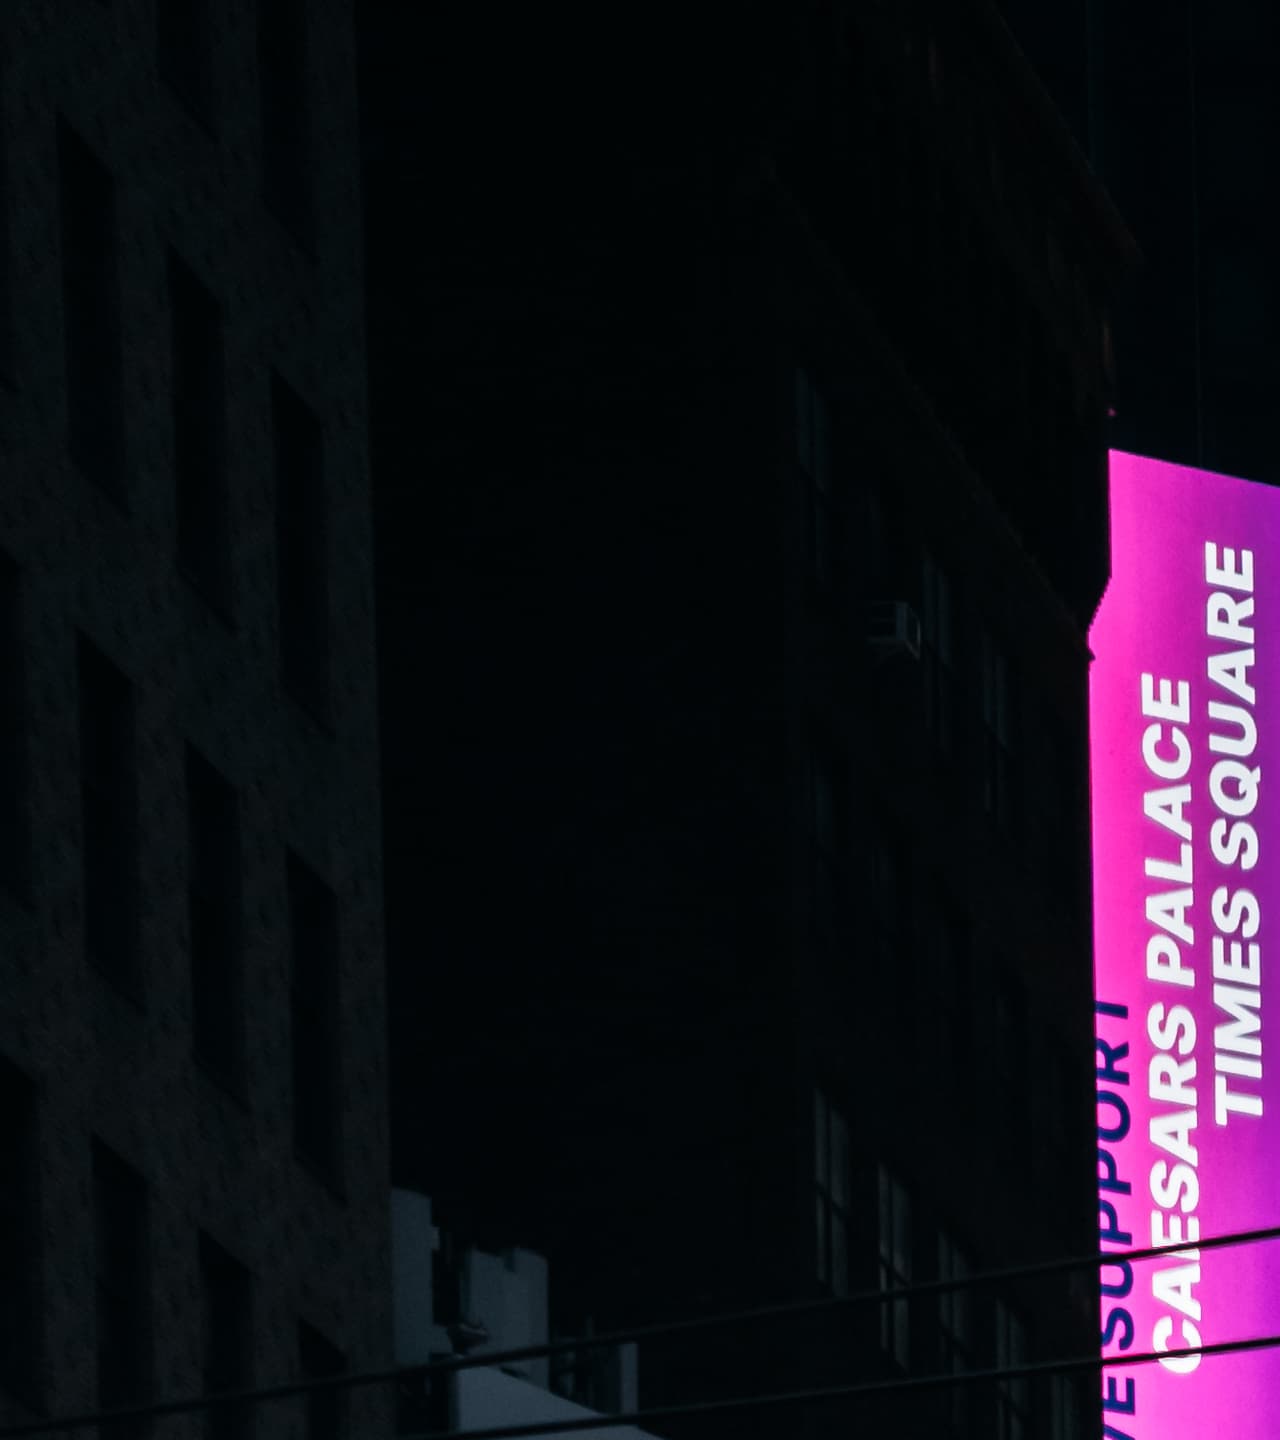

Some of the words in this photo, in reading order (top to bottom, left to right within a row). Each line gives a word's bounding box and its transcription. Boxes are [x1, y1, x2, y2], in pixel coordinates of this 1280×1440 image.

[1141, 672, 1196, 987] PALACE
[1205, 541, 1261, 871] SQUARE
[1211, 886, 1264, 1126] TIMES
[1146, 1001, 1202, 1374] CAESARS
